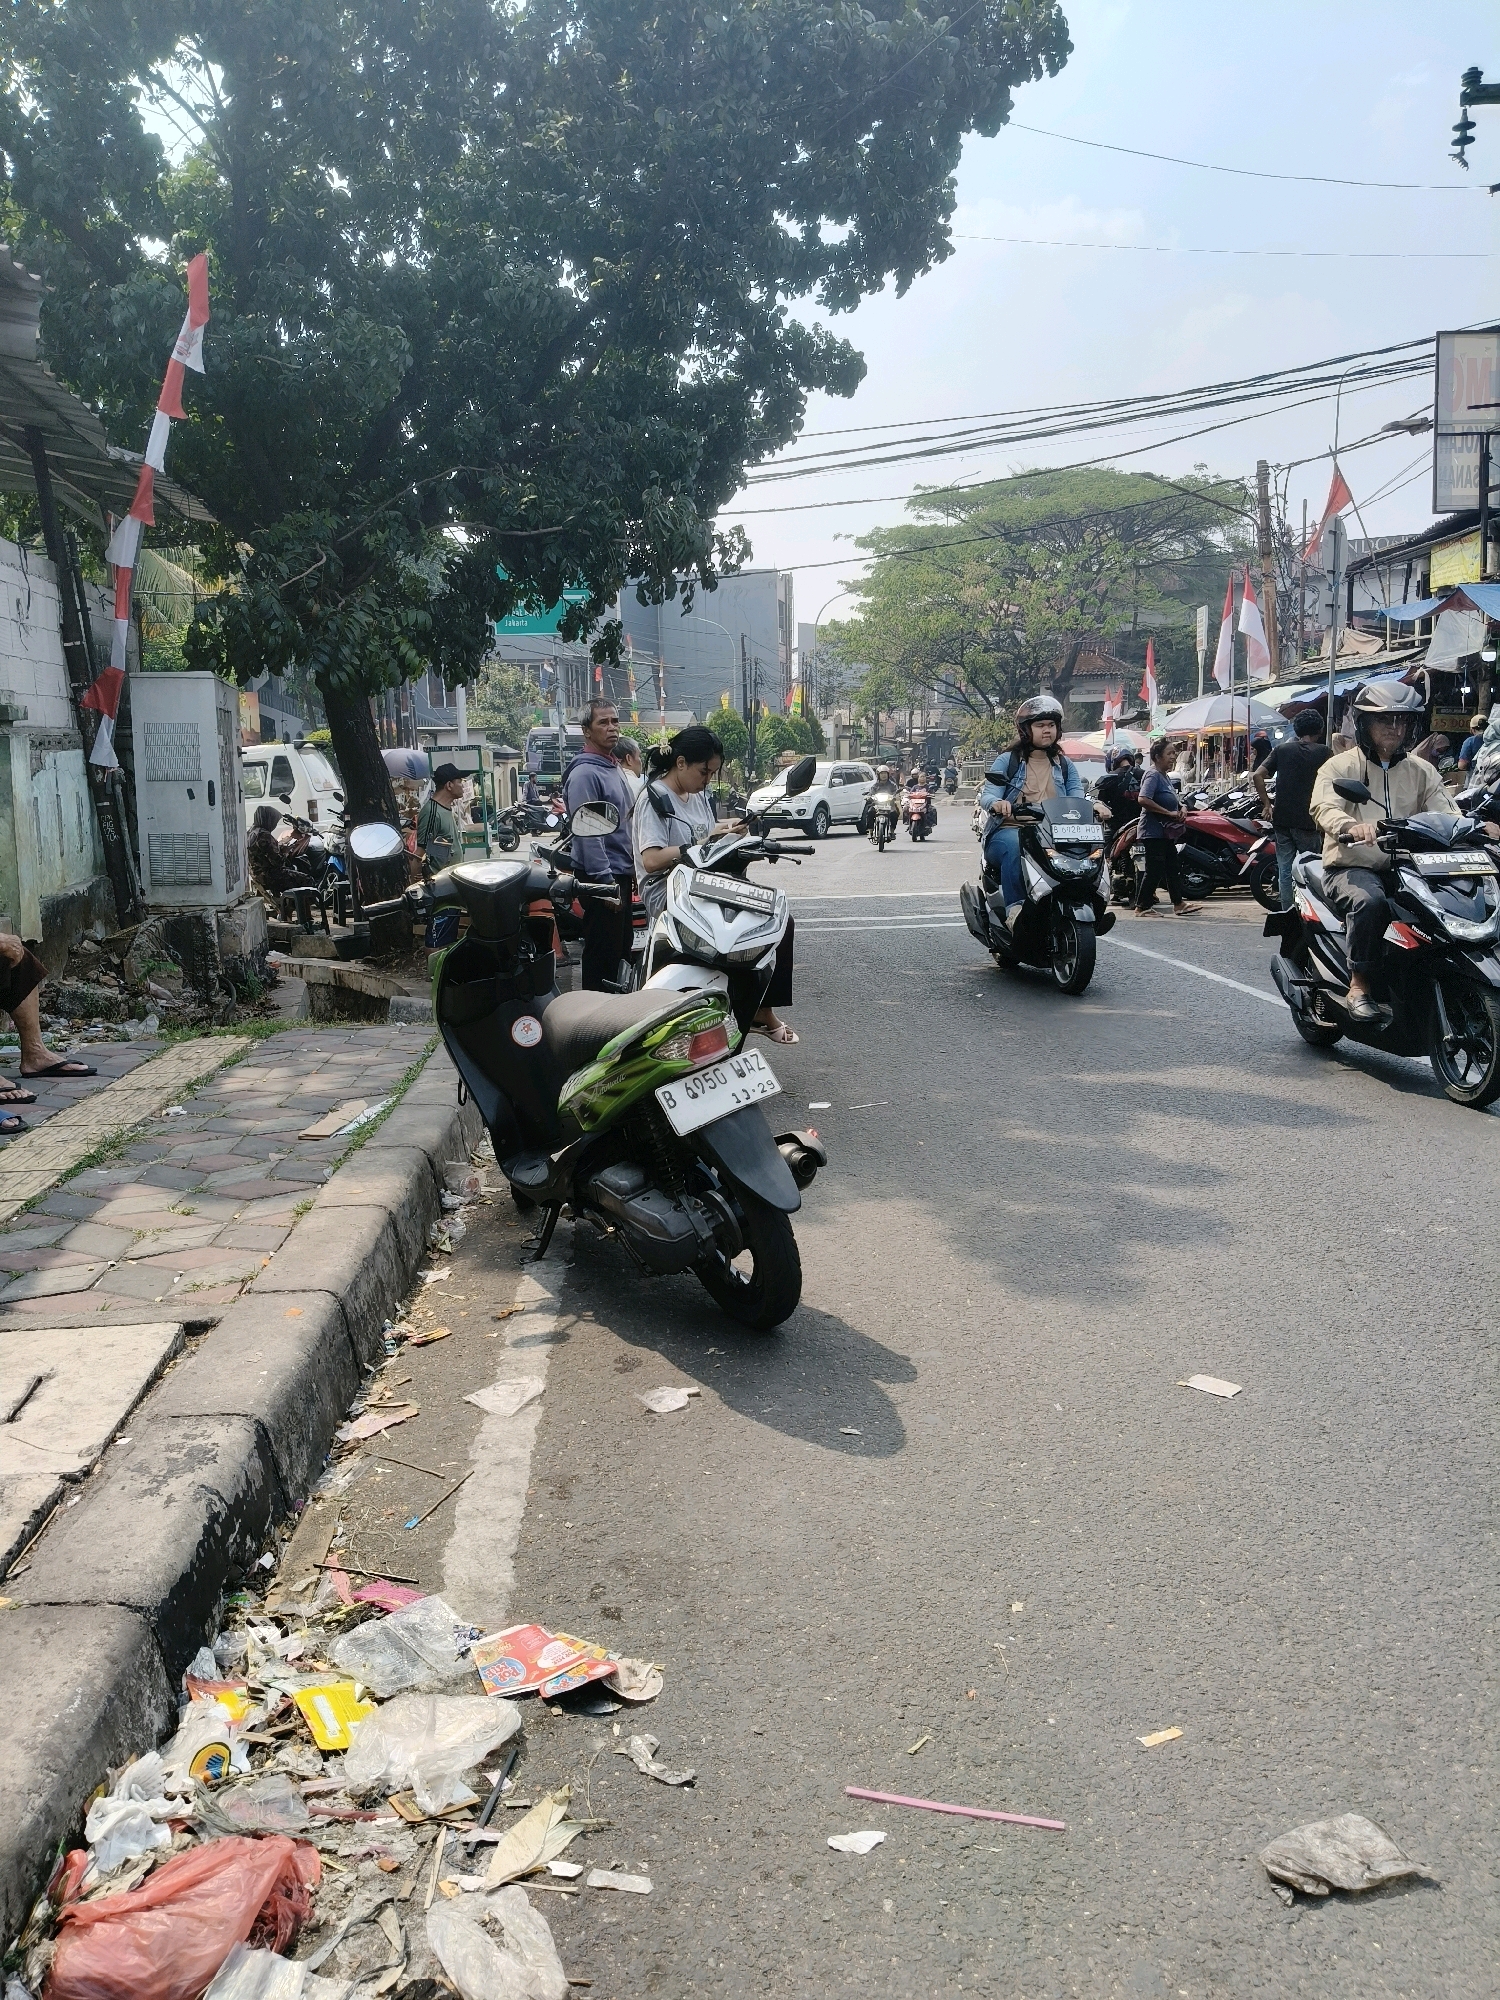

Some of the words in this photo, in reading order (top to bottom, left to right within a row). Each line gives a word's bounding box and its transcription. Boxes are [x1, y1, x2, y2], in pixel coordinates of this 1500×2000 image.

[505, 619, 528, 627] Jakarta
[711, 878, 742, 893] 6577
[696, 1016, 723, 1031] YAMAHA
[661, 1090, 677, 1110] B
[684, 1068, 728, 1100] 6950
[729, 1053, 766, 1079] WAZ
[483, 1661, 508, 1679] MIE
[499, 1667, 523, 1683] POP
